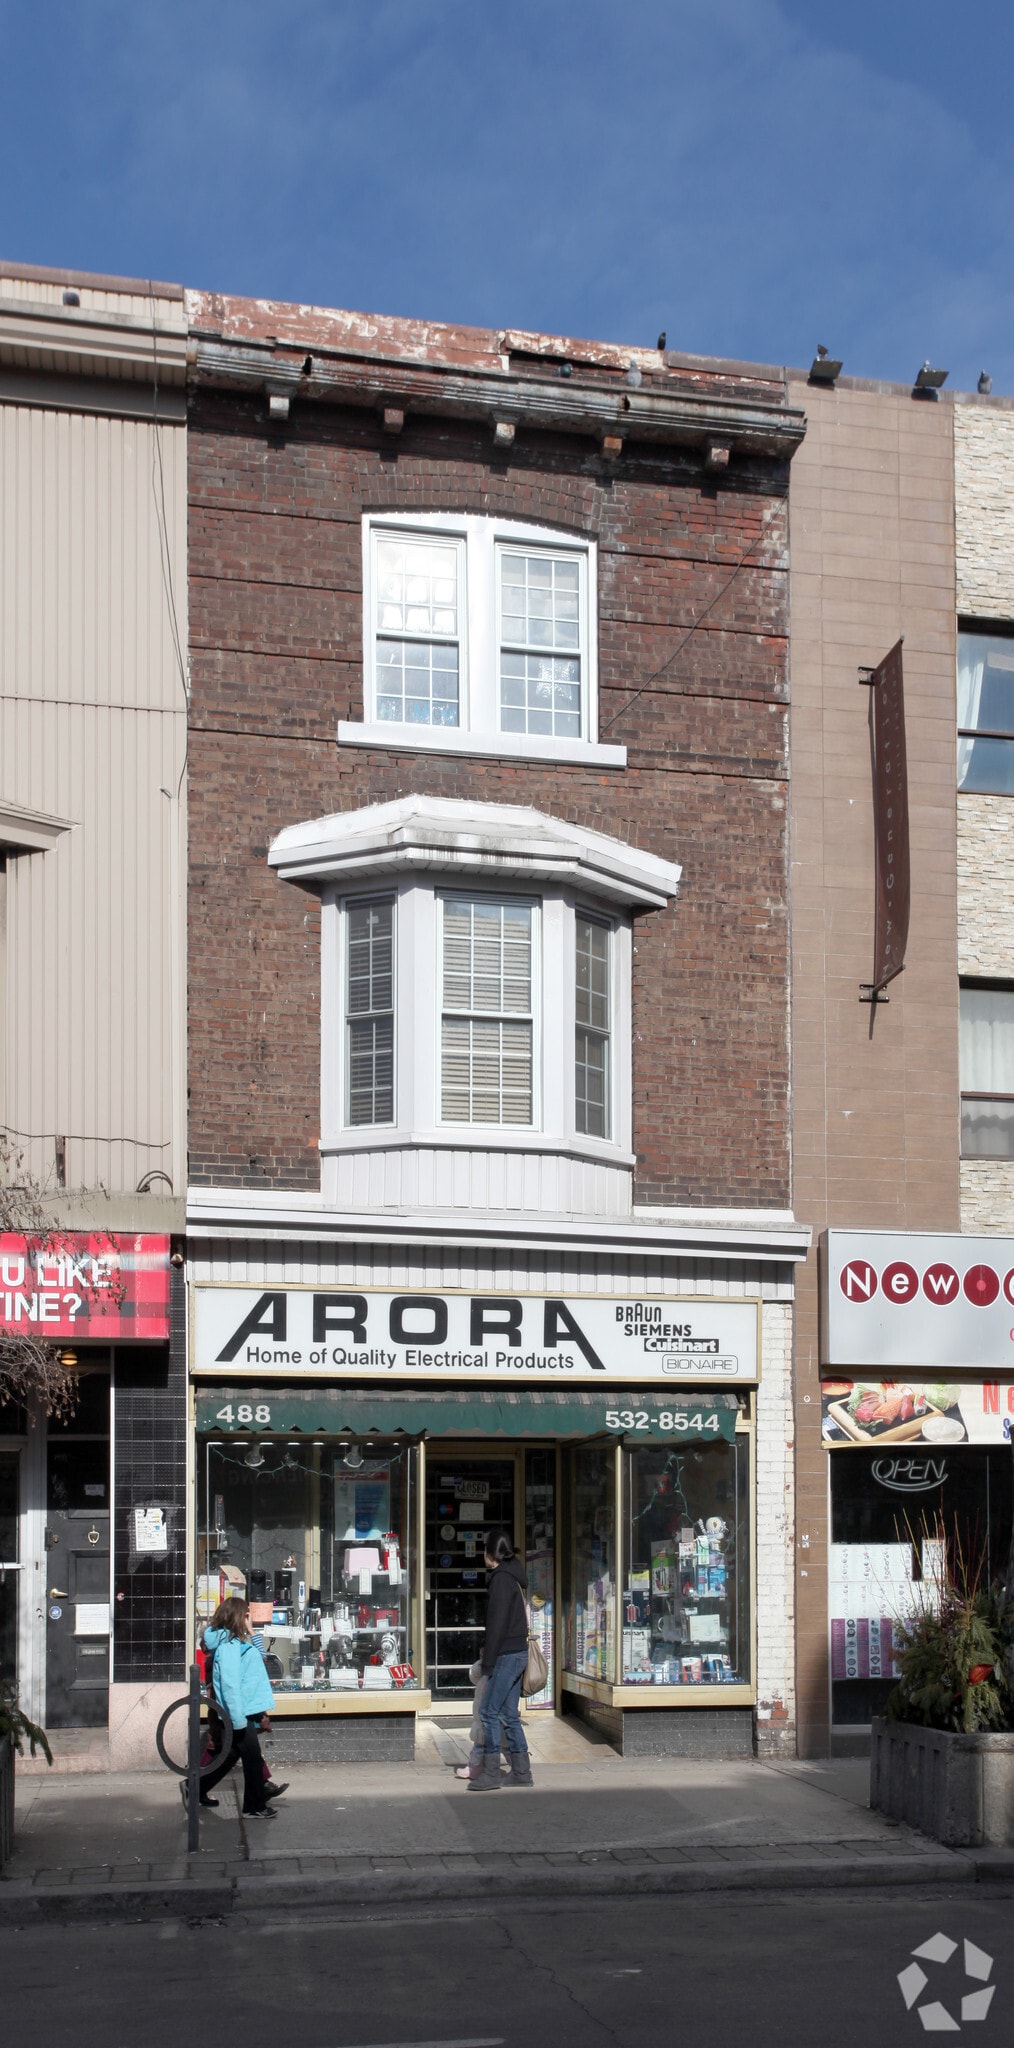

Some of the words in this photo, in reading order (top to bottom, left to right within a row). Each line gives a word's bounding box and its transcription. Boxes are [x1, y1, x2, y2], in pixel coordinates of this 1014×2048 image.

[37, 1258, 113, 1288] LIKE
[0, 1292, 82, 1322] INE?
[616, 1303, 662, 1322] BRAUN
[214, 1292, 606, 1370] ARORA
[624, 1324, 692, 1337] SIEMENS
[645, 1338, 717, 1353] Cuisinart
[247, 1347, 302, 1364] Home
[309, 1348, 327, 1364] of
[332, 1348, 397, 1368] Quality
[405, 1349, 487, 1367] Electrical
[496, 1352, 574, 1369] Products
[666, 1358, 733, 1370] BIONAIRE
[216, 1404, 271, 1423] 488
[605, 1411, 720, 1431] 532-8544
[875, 1459, 945, 1480] OPEN
